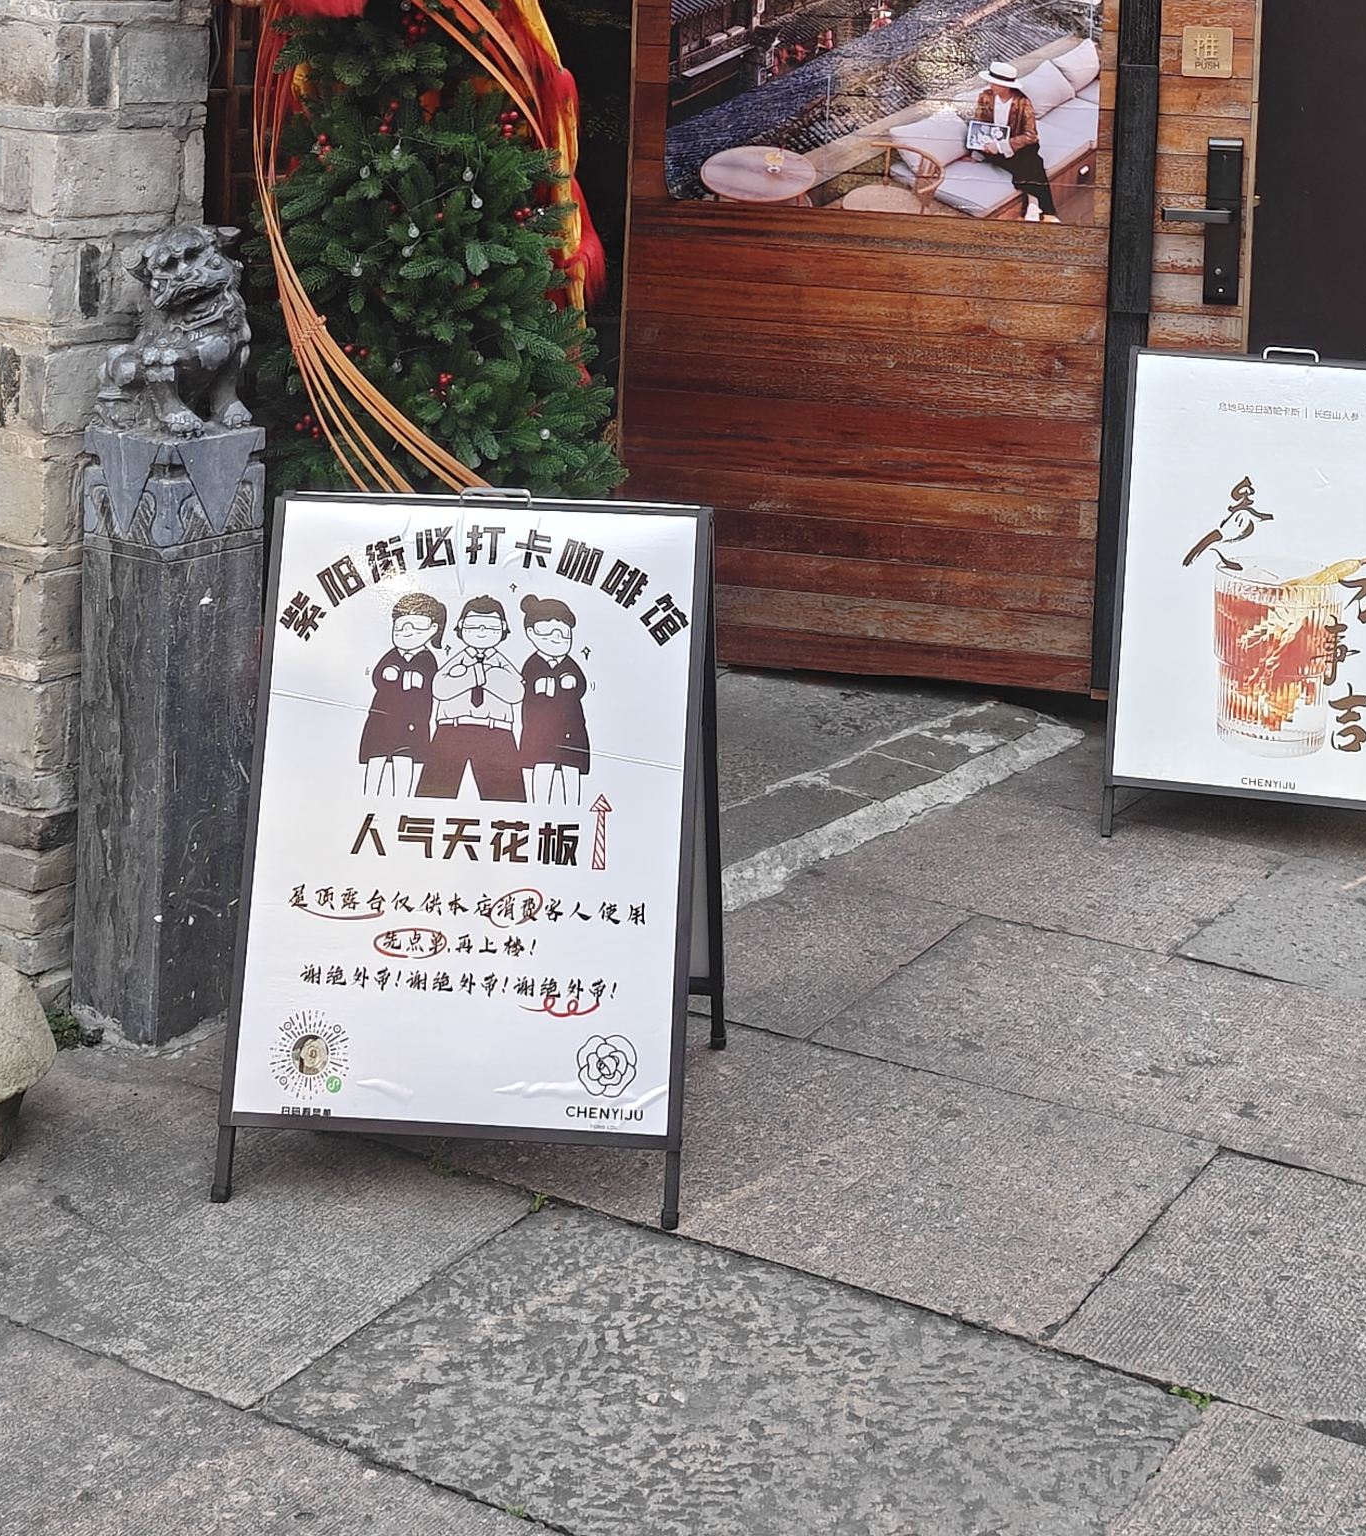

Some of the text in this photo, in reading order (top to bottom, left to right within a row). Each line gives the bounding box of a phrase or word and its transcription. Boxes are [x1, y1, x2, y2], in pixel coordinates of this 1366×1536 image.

[1193, 32, 1219, 61] 推
[1194, 61, 1220, 70] PUSH
[278, 524, 691, 647] 紫阳街必打卡咖啡馆
[1240, 776, 1296, 791] CHENYIJU
[349, 812, 581, 866] 人气天花板
[287, 883, 648, 926] 屋顶露台仅供本店消费客人使用
[565, 1105, 644, 1121] CHENYIJU
